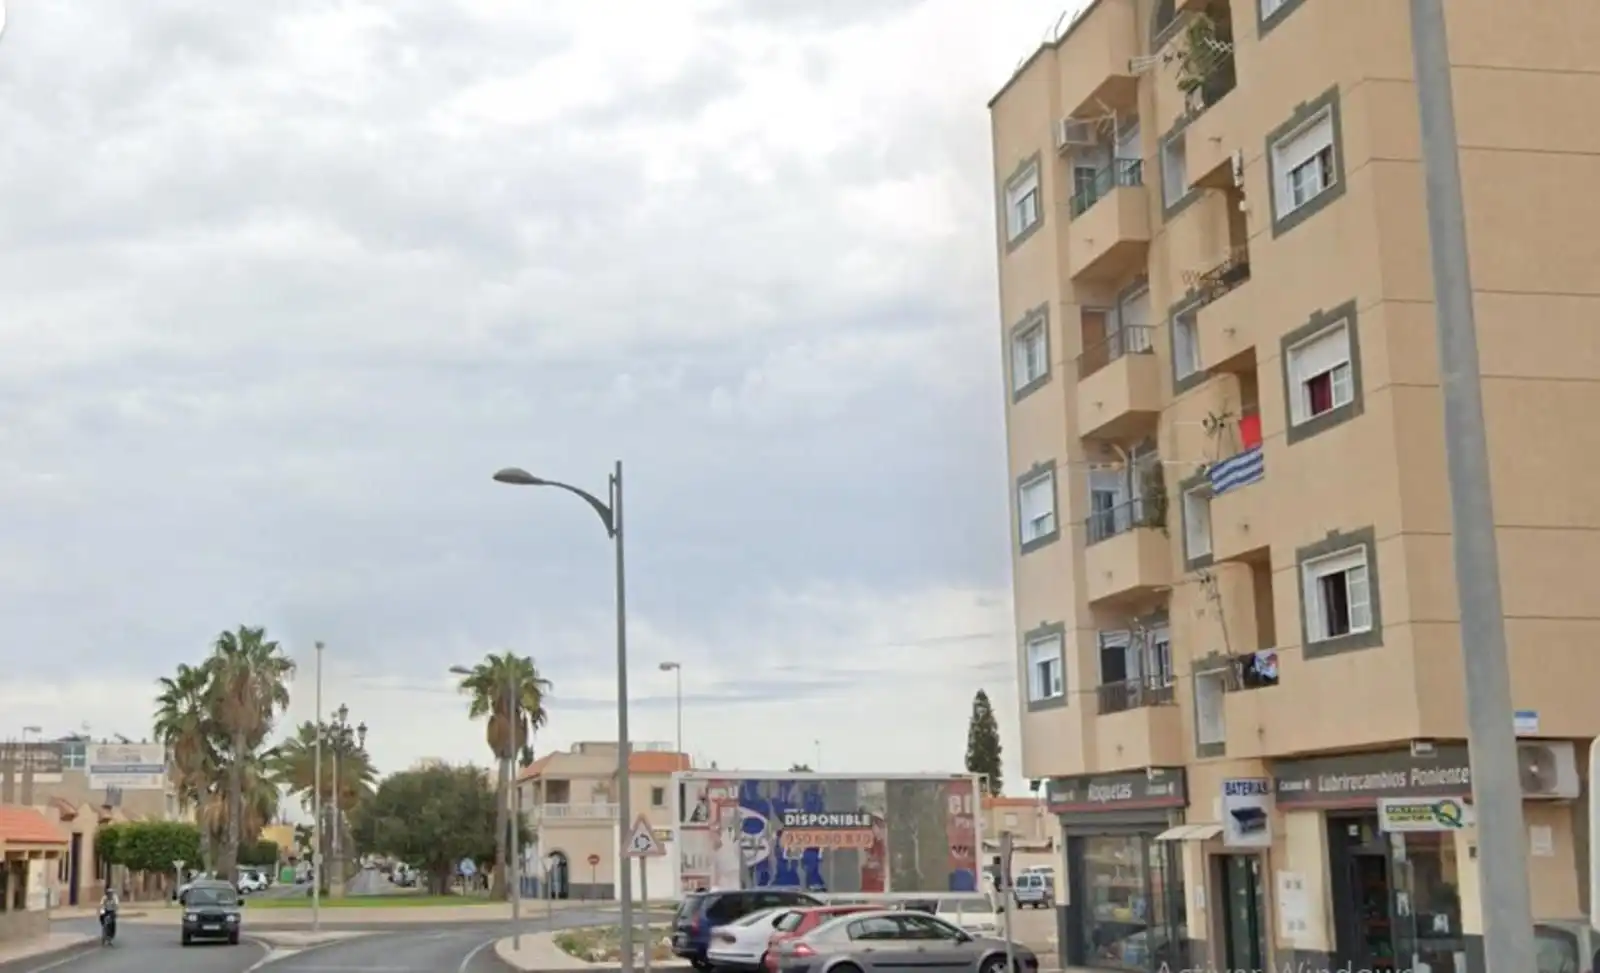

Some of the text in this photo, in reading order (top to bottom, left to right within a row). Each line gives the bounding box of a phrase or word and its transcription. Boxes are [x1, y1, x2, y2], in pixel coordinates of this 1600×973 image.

[1318, 771, 1406, 792] Lubrirecambios
[1411, 766, 1469, 787] Poniente
[785, 813, 871, 826] DISPONIBLE
